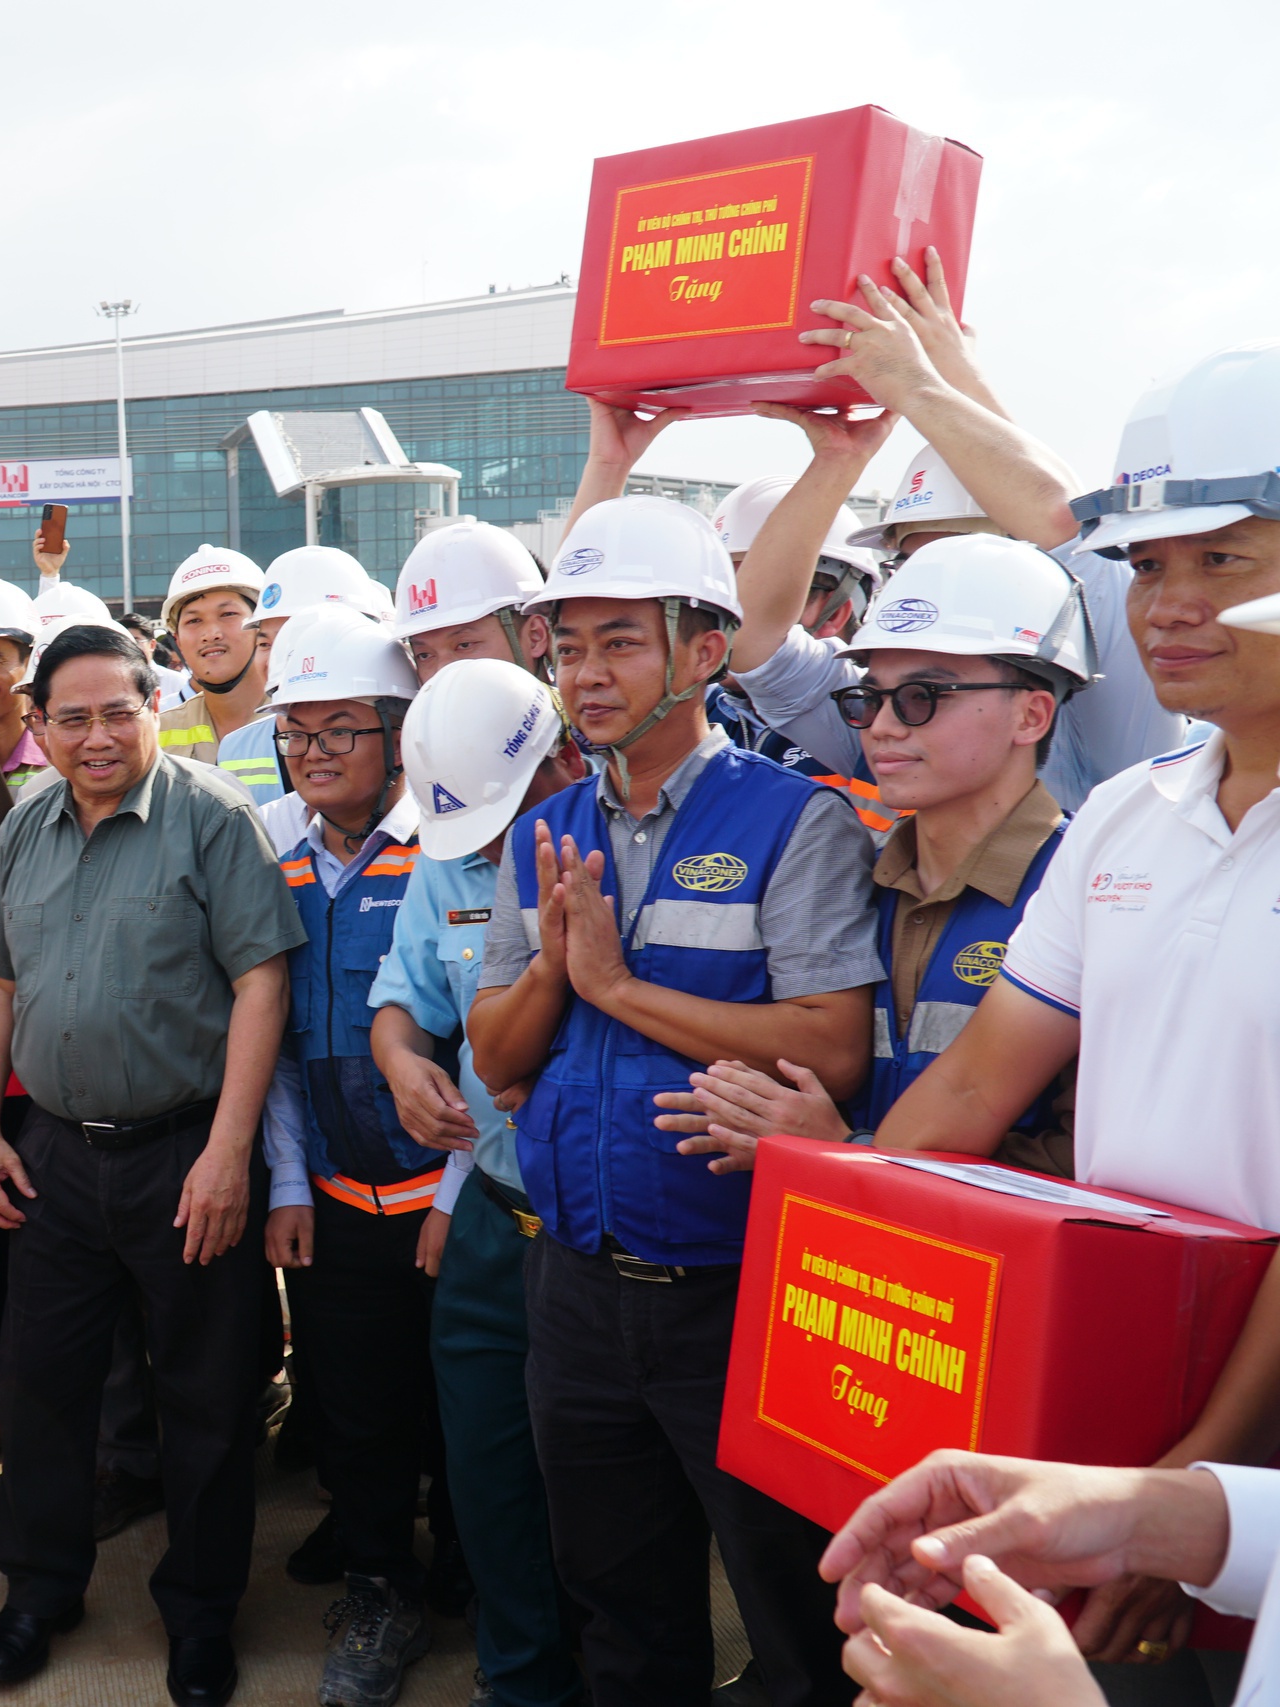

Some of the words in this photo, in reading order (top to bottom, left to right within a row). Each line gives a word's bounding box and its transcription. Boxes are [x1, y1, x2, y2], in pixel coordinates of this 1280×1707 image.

[621, 240, 672, 275] PHẠM
[675, 232, 725, 265] MINH
[728, 220, 788, 258] CHÍNH
[671, 275, 723, 304] Tặng
[1133, 464, 1172, 482] DEOCA
[182, 565, 230, 582] CONINCO
[881, 611, 934, 621] VINACONEX
[503, 729, 528, 758] TỔNG
[678, 865, 744, 878] VINACONEX
[782, 1283, 837, 1342] PHẠM
[838, 1305, 893, 1365] MINH
[896, 1329, 966, 1394] CHÍNH
[831, 1363, 888, 1428] Tặng
